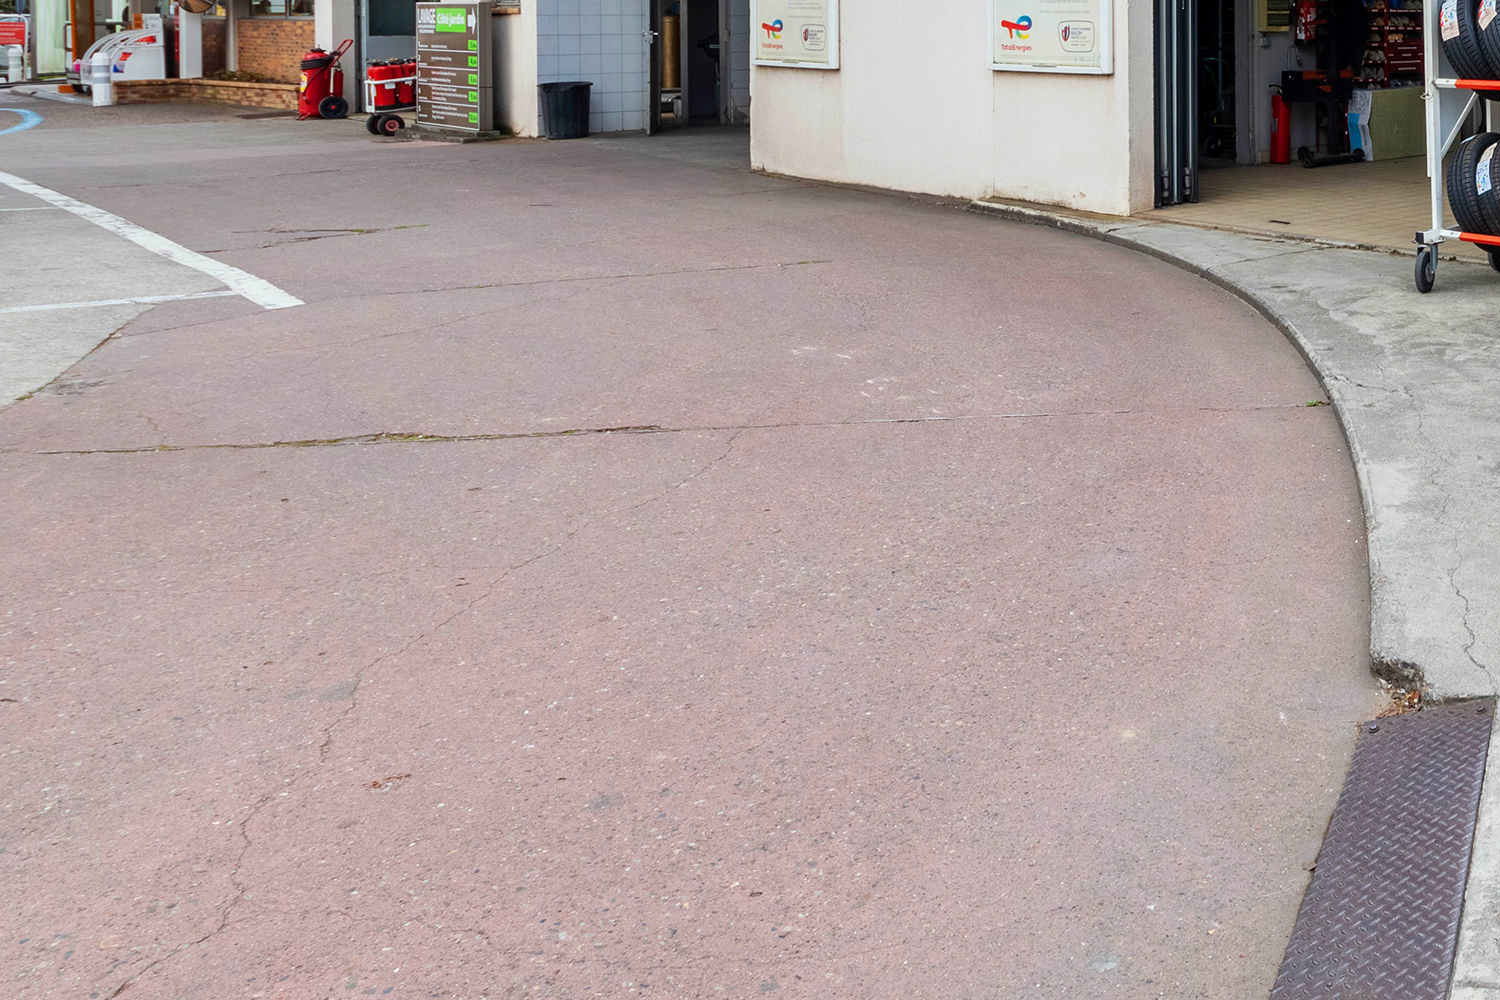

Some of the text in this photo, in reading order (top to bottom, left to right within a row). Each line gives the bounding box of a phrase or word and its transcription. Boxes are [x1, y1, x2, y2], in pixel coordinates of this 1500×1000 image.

[417, 8, 435, 24] LAVAGE
[448, 12, 465, 28] jardin
[761, 42, 784, 50] TotalEnergies
[1001, 43, 1032, 53] TotalEnergies
